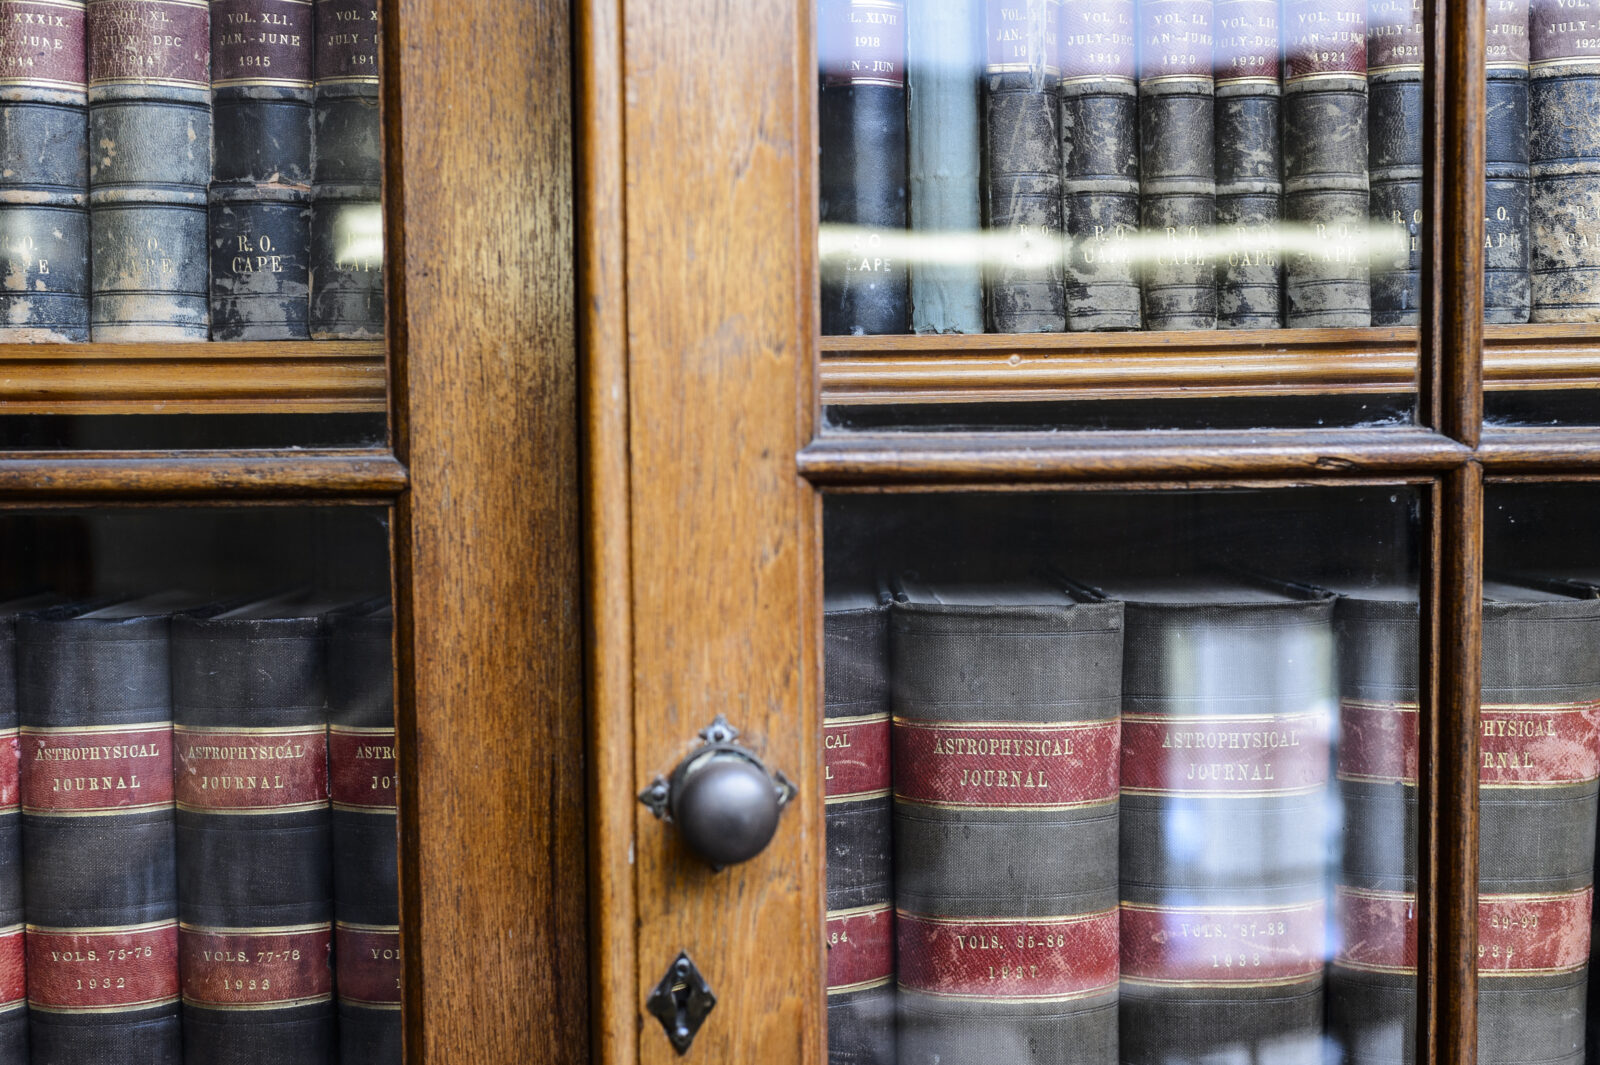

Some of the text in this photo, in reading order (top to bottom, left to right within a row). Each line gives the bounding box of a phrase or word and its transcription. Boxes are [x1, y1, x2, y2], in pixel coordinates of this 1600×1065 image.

[1371, 1, 1402, 13] VOL.
[14, 13, 72, 27] XXXIX.
[149, 11, 173, 23] XL.
[228, 13, 293, 26] VOL. XLI.
[866, 14, 897, 26] XLVII
[1001, 9, 1026, 22] VOL.
[1083, 12, 1113, 23] VOL.
[1154, 13, 1208, 26] VOL. LI.
[1299, 11, 1364, 25] VOL. LIII.
[1221, 16, 1279, 30] VOL. LII.
[20, 36, 63, 49] JUNE
[153, 35, 183, 47] DEC
[855, 36, 880, 48] 1918
[1314, 52, 1346, 62] 1921
[1391, 45, 1418, 57] 1921
[239, 56, 271, 67] 1915
[873, 60, 895, 73] JUN
[1163, 54, 1196, 65] 1920
[1231, 55, 1265, 67] 1920
[1392, 210, 1407, 225] R.
[1496, 206, 1510, 221] O.
[1576, 205, 1591, 220] R.
[1094, 224, 1129, 241] R. O.
[238, 234, 276, 252] R. O.
[232, 255, 283, 273] CAPE
[1162, 730, 1300, 749] ASTROPHYSICAL
[35, 743, 160, 761] ASTROPHYSICAL
[188, 745, 306, 760] ASTROPHYSICAL
[933, 737, 1075, 757] ASTROPHYSICAL
[959, 768, 1049, 788] JOURNAL
[1187, 763, 1275, 781] JOURNAL
[53, 775, 141, 792] JOURNAL
[201, 775, 284, 790] JOURNAL
[1181, 921, 1285, 938] VOLS. 87-88
[957, 934, 1066, 950] VOLS. 85-86
[51, 947, 152, 962] VOLS. 75-76
[204, 949, 300, 963] VOLS. 77-78
[988, 965, 1037, 980] 1937
[76, 977, 126, 990] 1932
[224, 979, 270, 990] 1933
